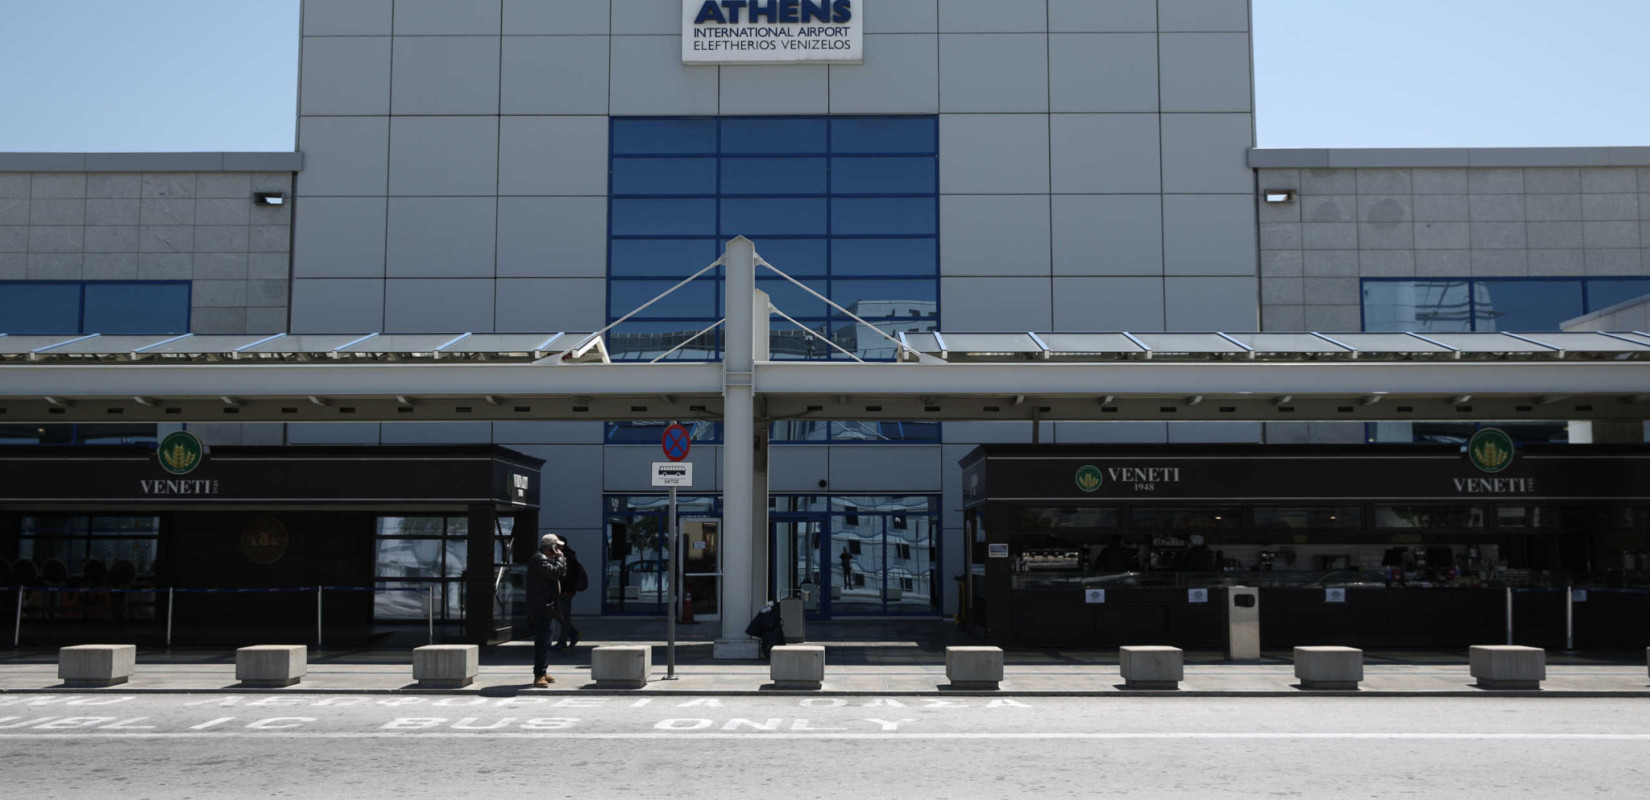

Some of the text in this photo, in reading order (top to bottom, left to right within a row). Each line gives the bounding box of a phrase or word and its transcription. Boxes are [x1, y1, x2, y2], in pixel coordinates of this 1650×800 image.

[694, 0, 852, 24] ATHENS
[694, 27, 851, 38] INTERNATIONAL AIRPORT
[694, 39, 851, 51] ELEFTHERIOS VENIZELOS
[1108, 467, 1180, 482] VENETI
[140, 479, 211, 494] VENETI
[1134, 483, 1155, 491] 1948
[1453, 478, 1525, 492] VENETI
[379, 717, 581, 730] BUS
[653, 718, 918, 731] ONLY
